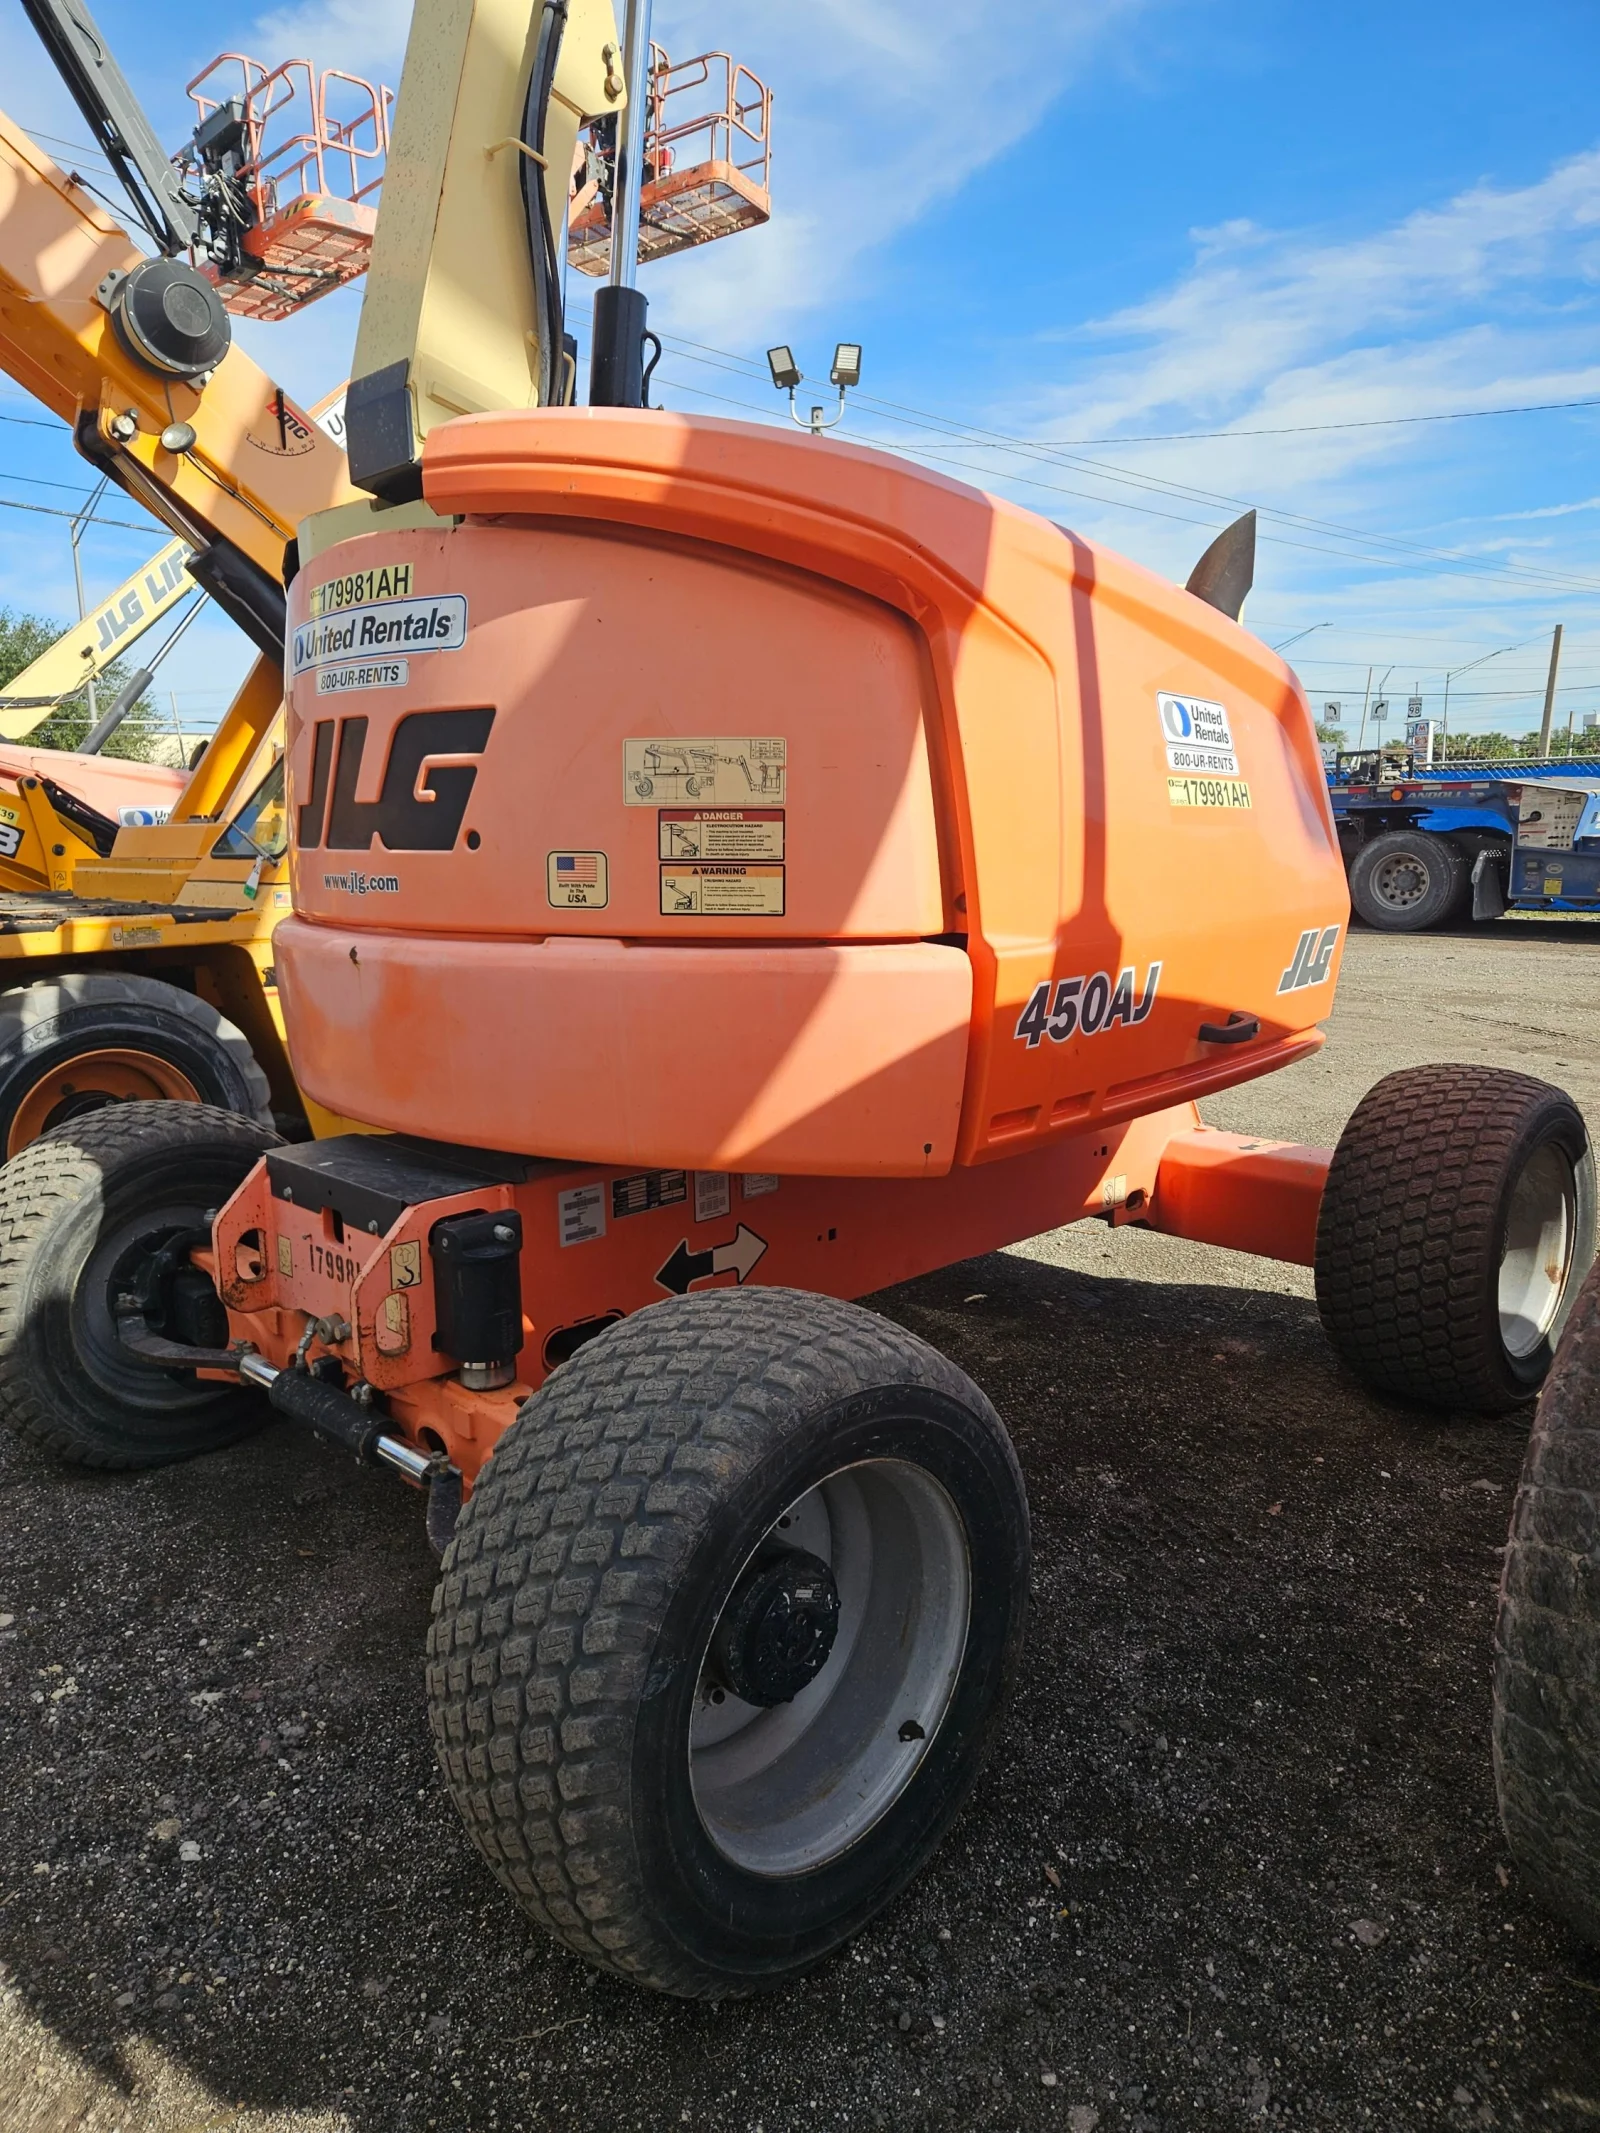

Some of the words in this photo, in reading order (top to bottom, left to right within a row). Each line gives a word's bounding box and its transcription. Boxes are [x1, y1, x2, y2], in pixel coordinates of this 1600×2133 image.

[321, 565, 410, 612] 179981AH
[96, 588, 145, 652] JLG
[305, 619, 356, 660] United
[360, 607, 452, 646] Rentals
[320, 665, 400, 690] 800-UR-RENTS
[1191, 705, 1222, 725] United
[1409, 706, 1420, 715] 98
[1195, 724, 1229, 744] Rentals
[1174, 752, 1234, 771] 800-UR-RENTS
[298, 708, 497, 851] JLG
[1183, 780, 1250, 807] 179981AH
[324, 873, 399, 894] www.jlg.com
[701, 867, 747, 875] WARNING
[568, 894, 587, 903] USA
[1277, 925, 1340, 994] JLG
[1015, 962, 1162, 1047] 450AJ
